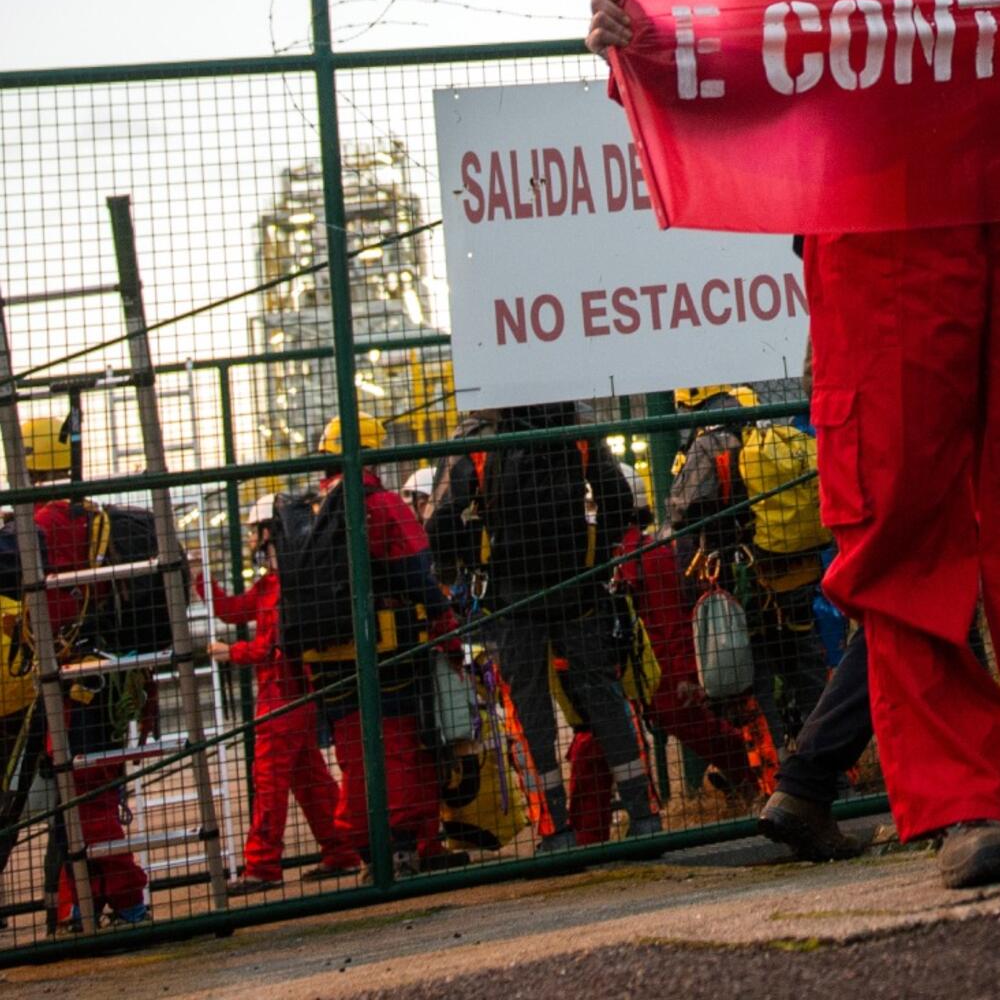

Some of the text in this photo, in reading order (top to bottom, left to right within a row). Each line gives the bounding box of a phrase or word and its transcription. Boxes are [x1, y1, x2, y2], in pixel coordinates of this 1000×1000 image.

[673, 4, 724, 100] E
[460, 145, 595, 224] SALIDA
[494, 293, 564, 346] NO
